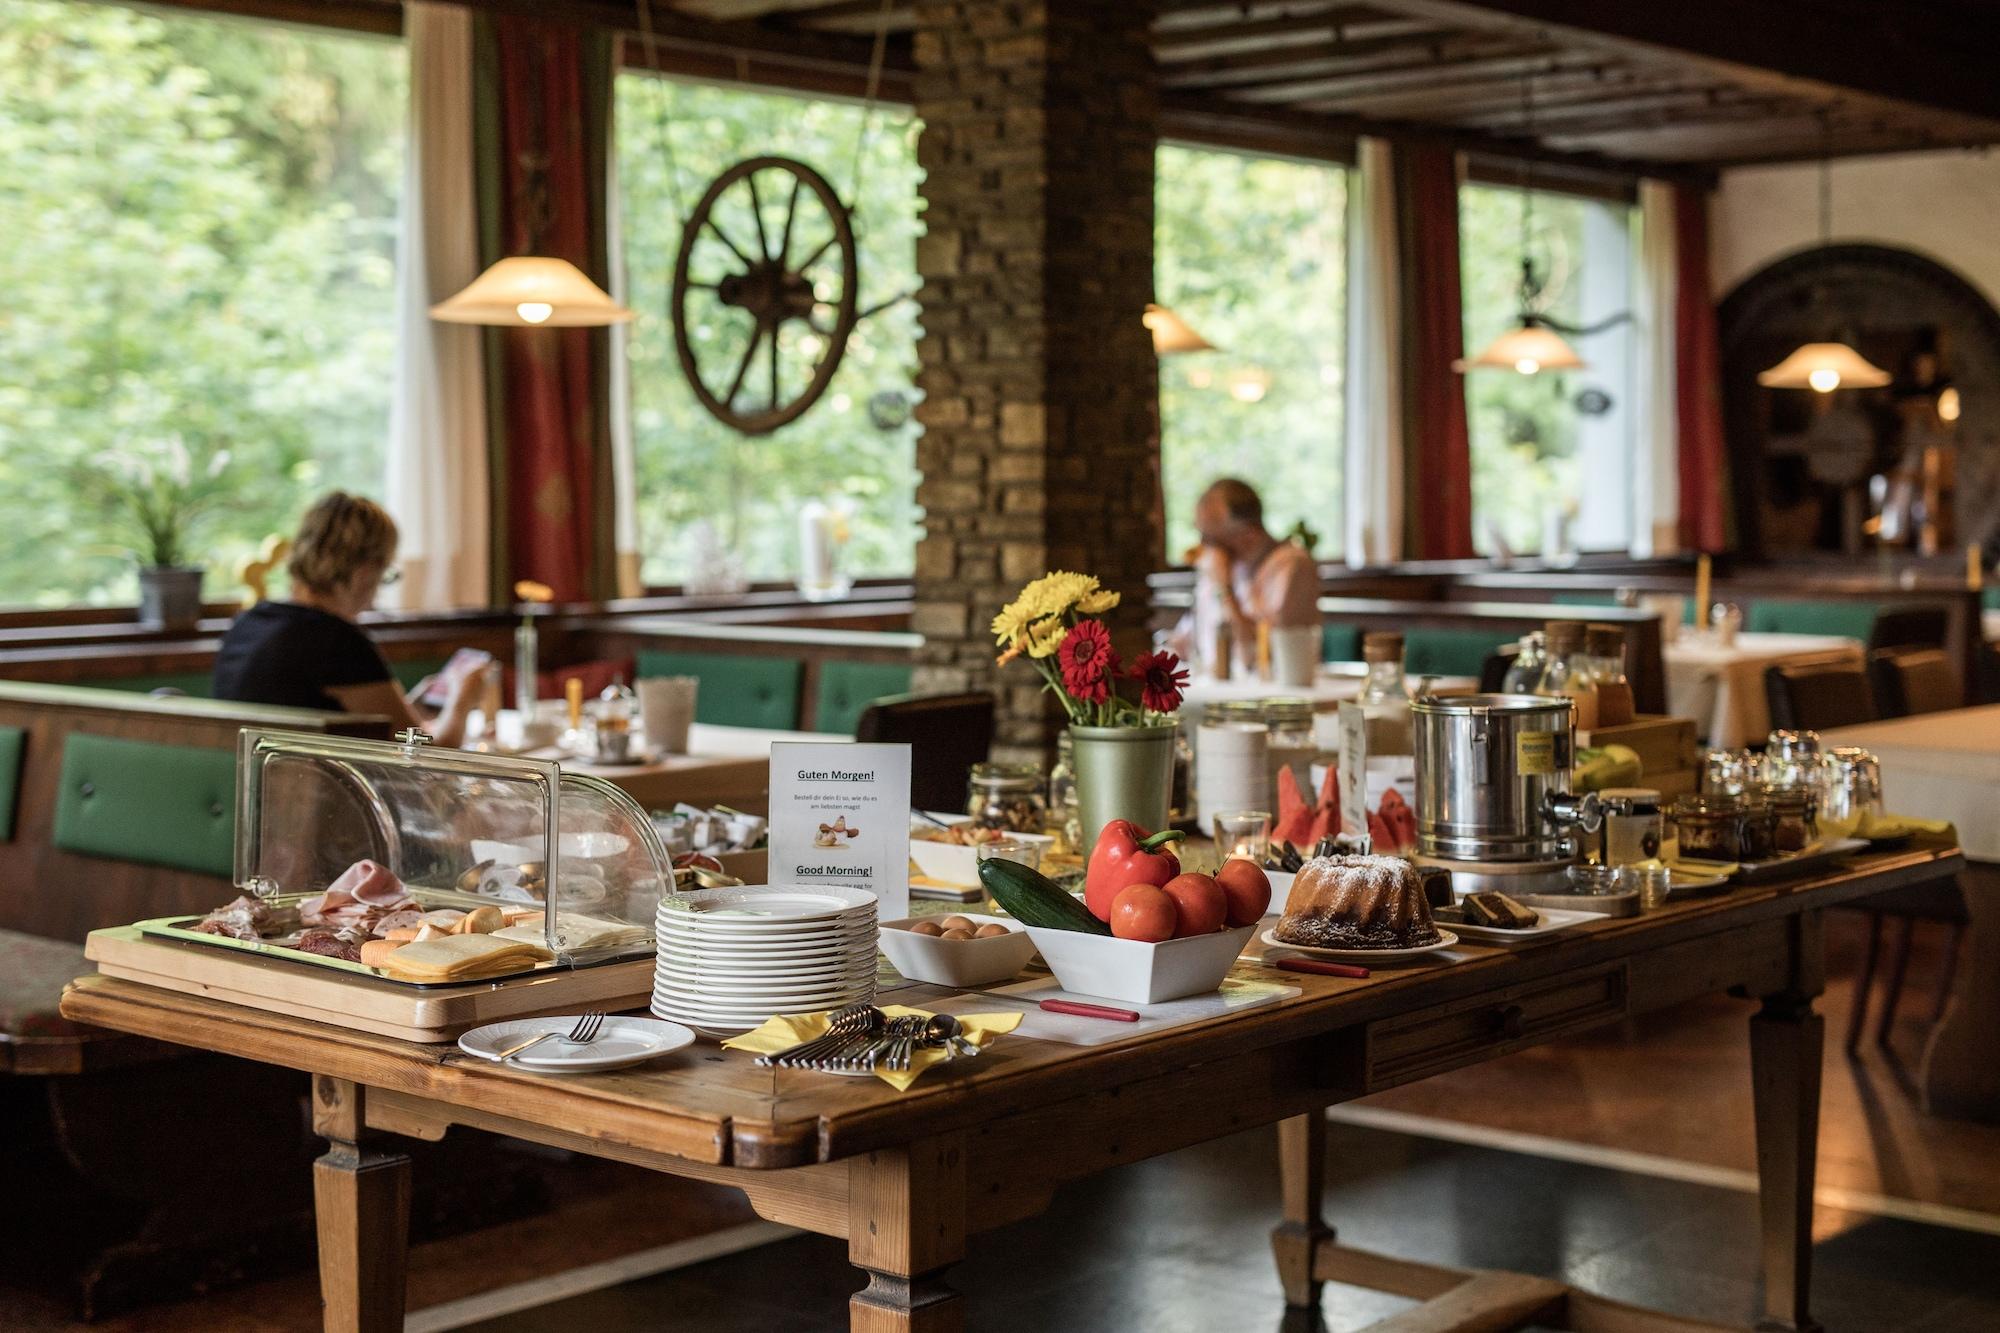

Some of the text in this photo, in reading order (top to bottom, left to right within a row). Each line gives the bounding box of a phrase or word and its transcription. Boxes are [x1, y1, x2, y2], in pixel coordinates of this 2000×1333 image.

[798, 770, 874, 781] Guten Morgen!
[796, 865, 873, 877] Good Morning!
